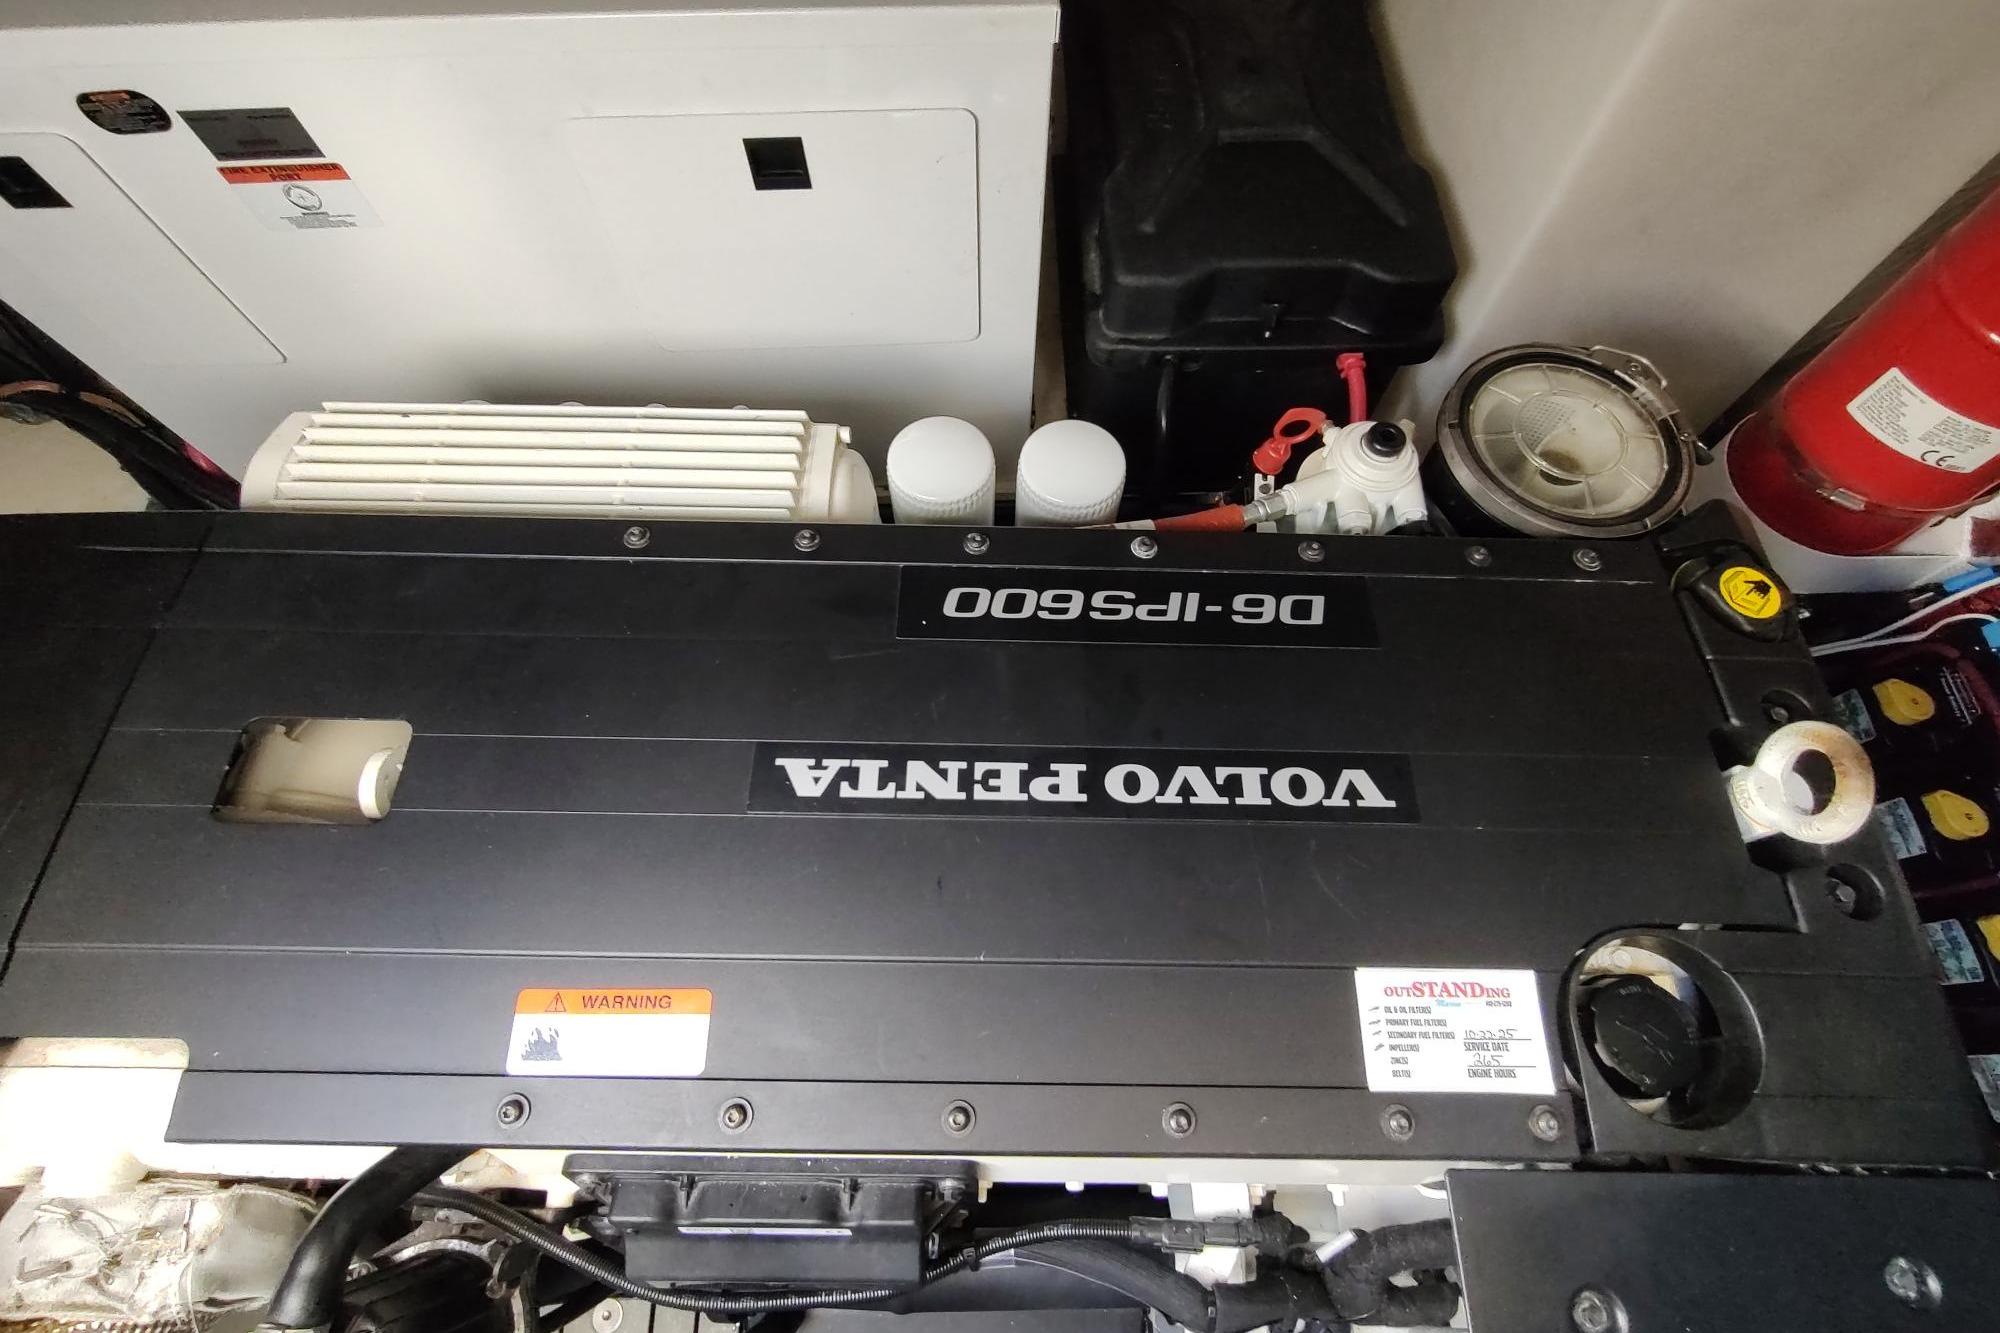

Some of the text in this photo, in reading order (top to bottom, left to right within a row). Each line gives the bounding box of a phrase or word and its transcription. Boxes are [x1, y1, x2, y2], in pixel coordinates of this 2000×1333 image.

[942, 587, 1326, 625] D6-IPS600
[774, 757, 1397, 808] VOLVO PENTA
[582, 994, 672, 1009] WARNING
[1399, 1006, 1408, 1014] OIL
[1385, 1019, 1409, 1027] PRIMARY
[1410, 1019, 1423, 1027] FUEL
[1387, 1031, 1417, 1039] SECONDARY
[1418, 1031, 1431, 1039] FUEL
[1464, 1042, 1510, 1052] SERVICE DATE
[1472, 1052, 1504, 1067] 365
[1467, 1068, 1517, 1079] ENGINE HOURS
